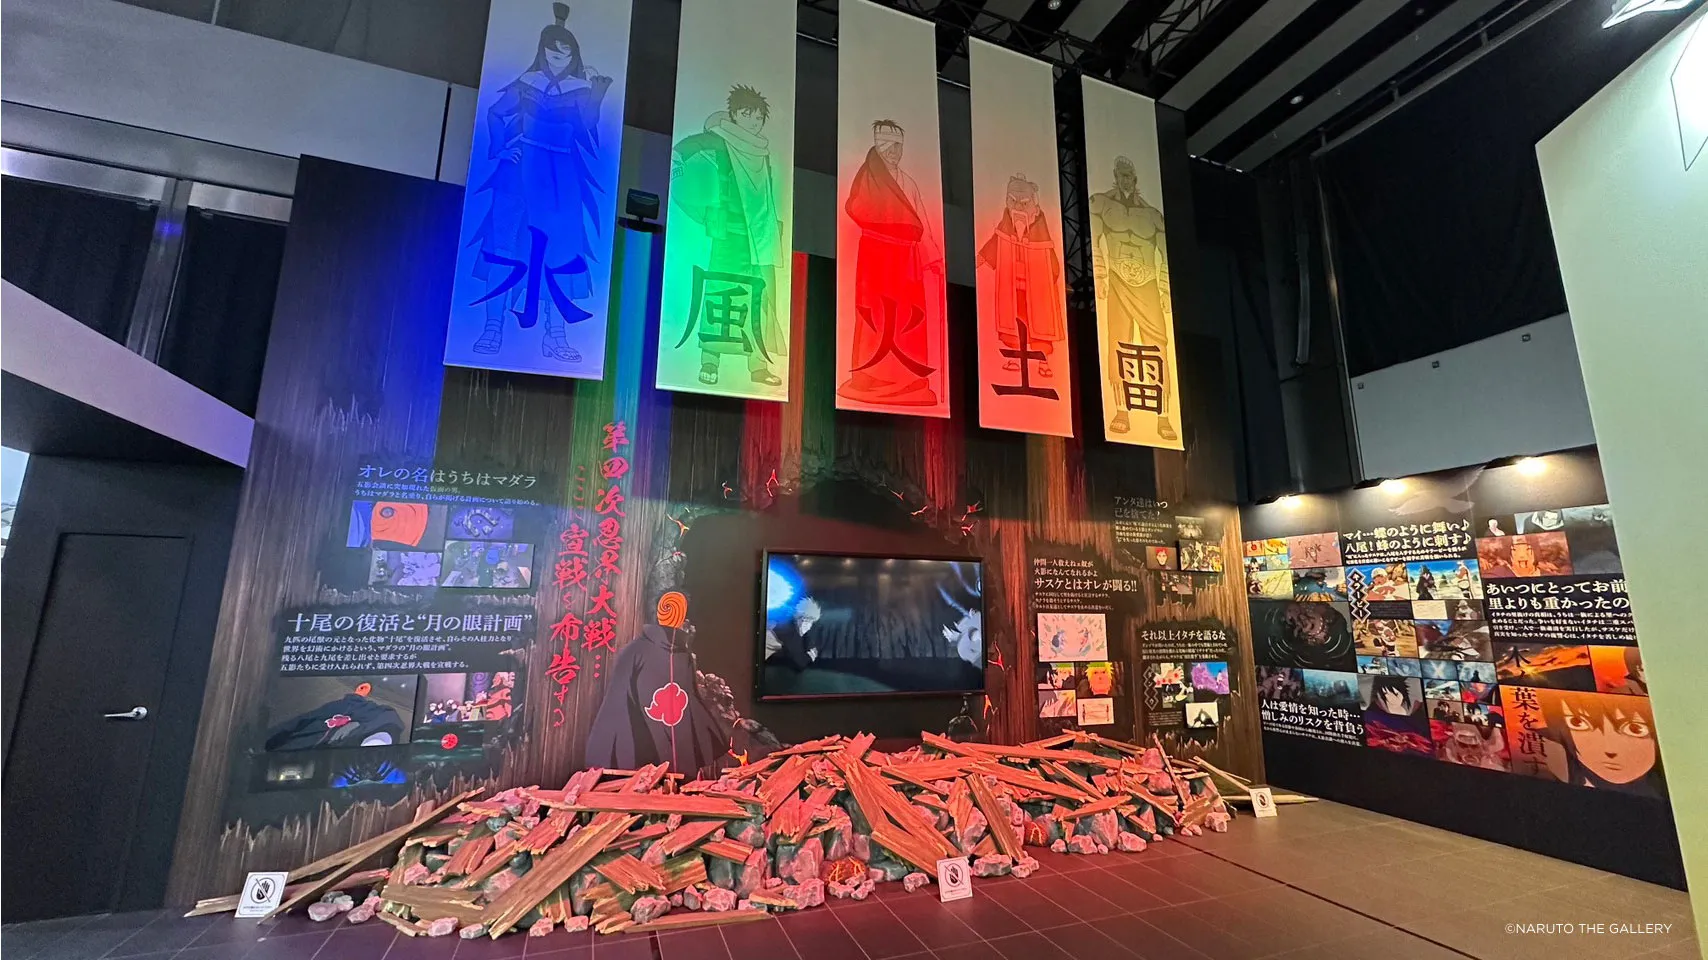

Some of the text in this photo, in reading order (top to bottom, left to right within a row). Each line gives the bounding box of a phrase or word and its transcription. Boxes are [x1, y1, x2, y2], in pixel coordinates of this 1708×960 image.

[469, 225, 593, 329] 水
[675, 265, 774, 364] 風
[849, 295, 937, 378] 火
[991, 317, 1060, 401] 土
[1117, 340, 1164, 416] 雷
[358, 464, 537, 489] オレの名はうちはマダラ
[1486, 579, 1628, 595] あいつにとってお前
[1488, 596, 1630, 610] 里よりも重かったの
[288, 612, 532, 632] 十尾の復活と“月の眼計画”
[1141, 629, 1226, 641] それ以上イタチを語るな
[1261, 709, 1364, 735] 憎しみのリスクを背負う
